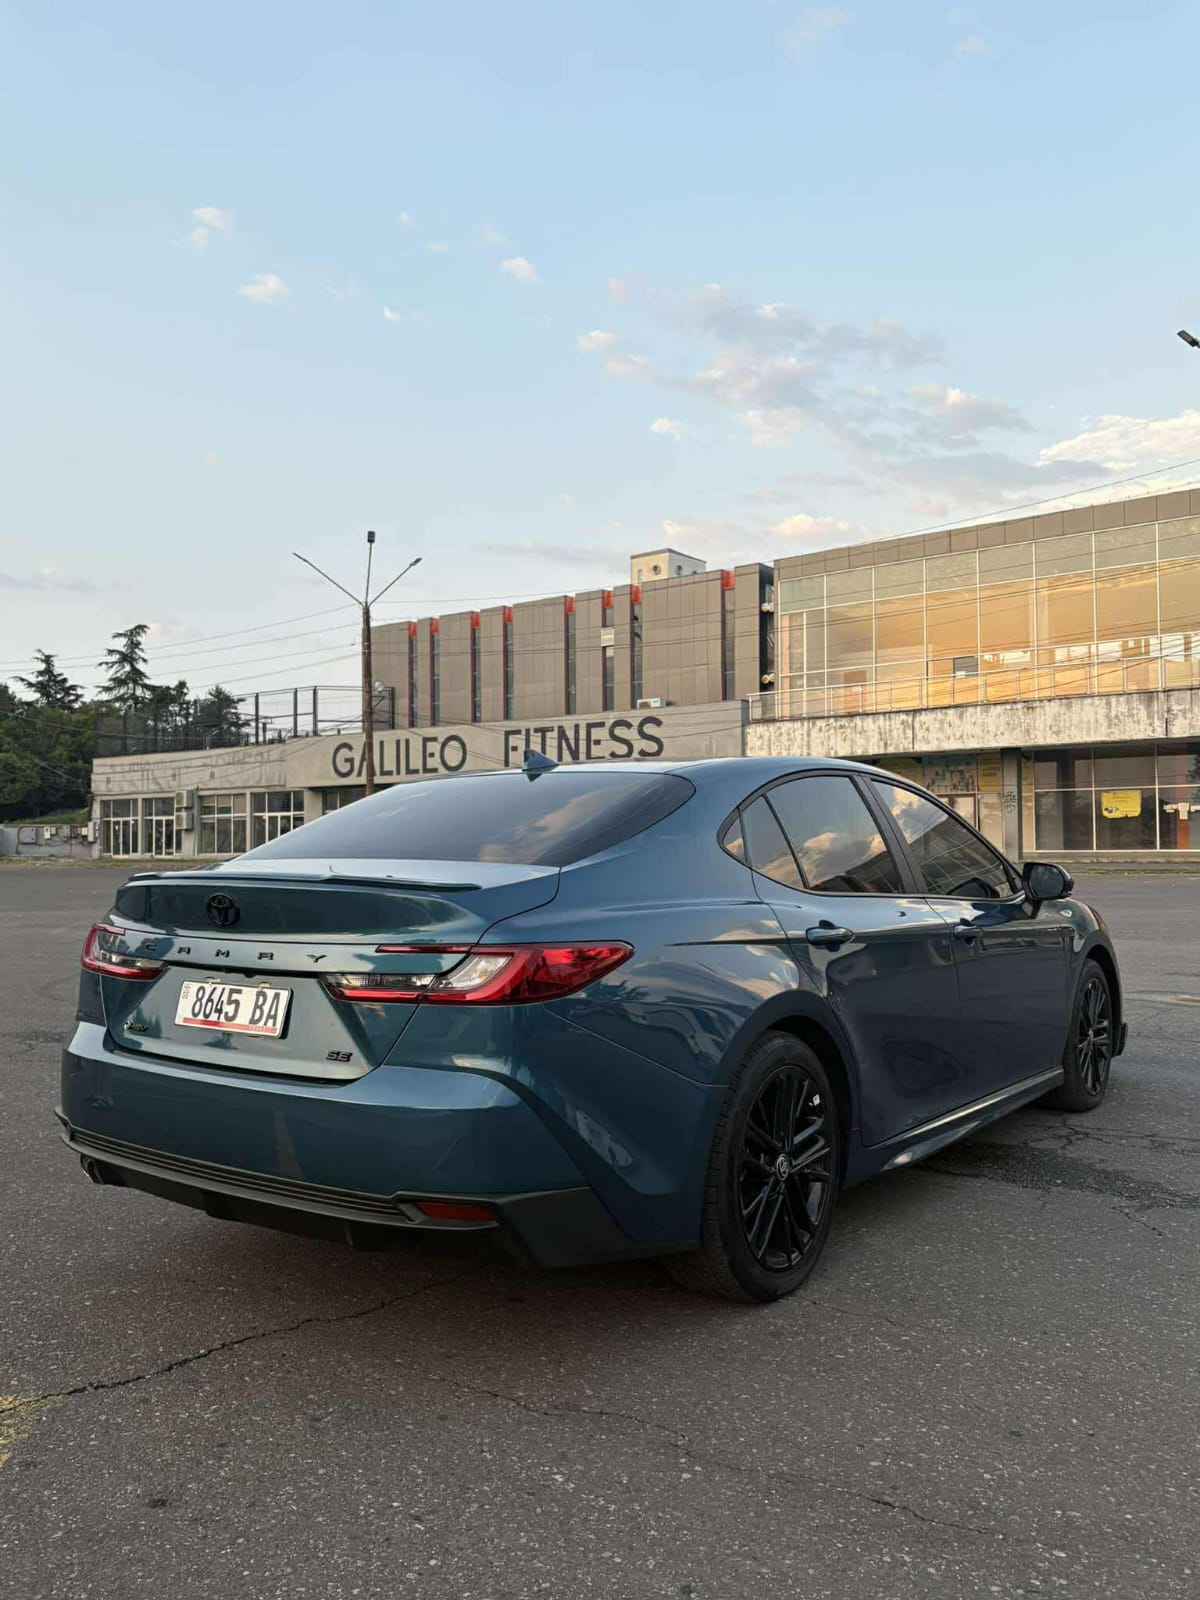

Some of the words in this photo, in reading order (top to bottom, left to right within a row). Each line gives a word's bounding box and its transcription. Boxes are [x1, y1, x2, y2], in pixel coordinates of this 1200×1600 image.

[332, 734, 467, 778] GALILEO
[504, 716, 664, 767] FITNESS
[191, 986, 243, 1022] 8645
[249, 990, 281, 1027] BA
[326, 1050, 353, 1062] SE
